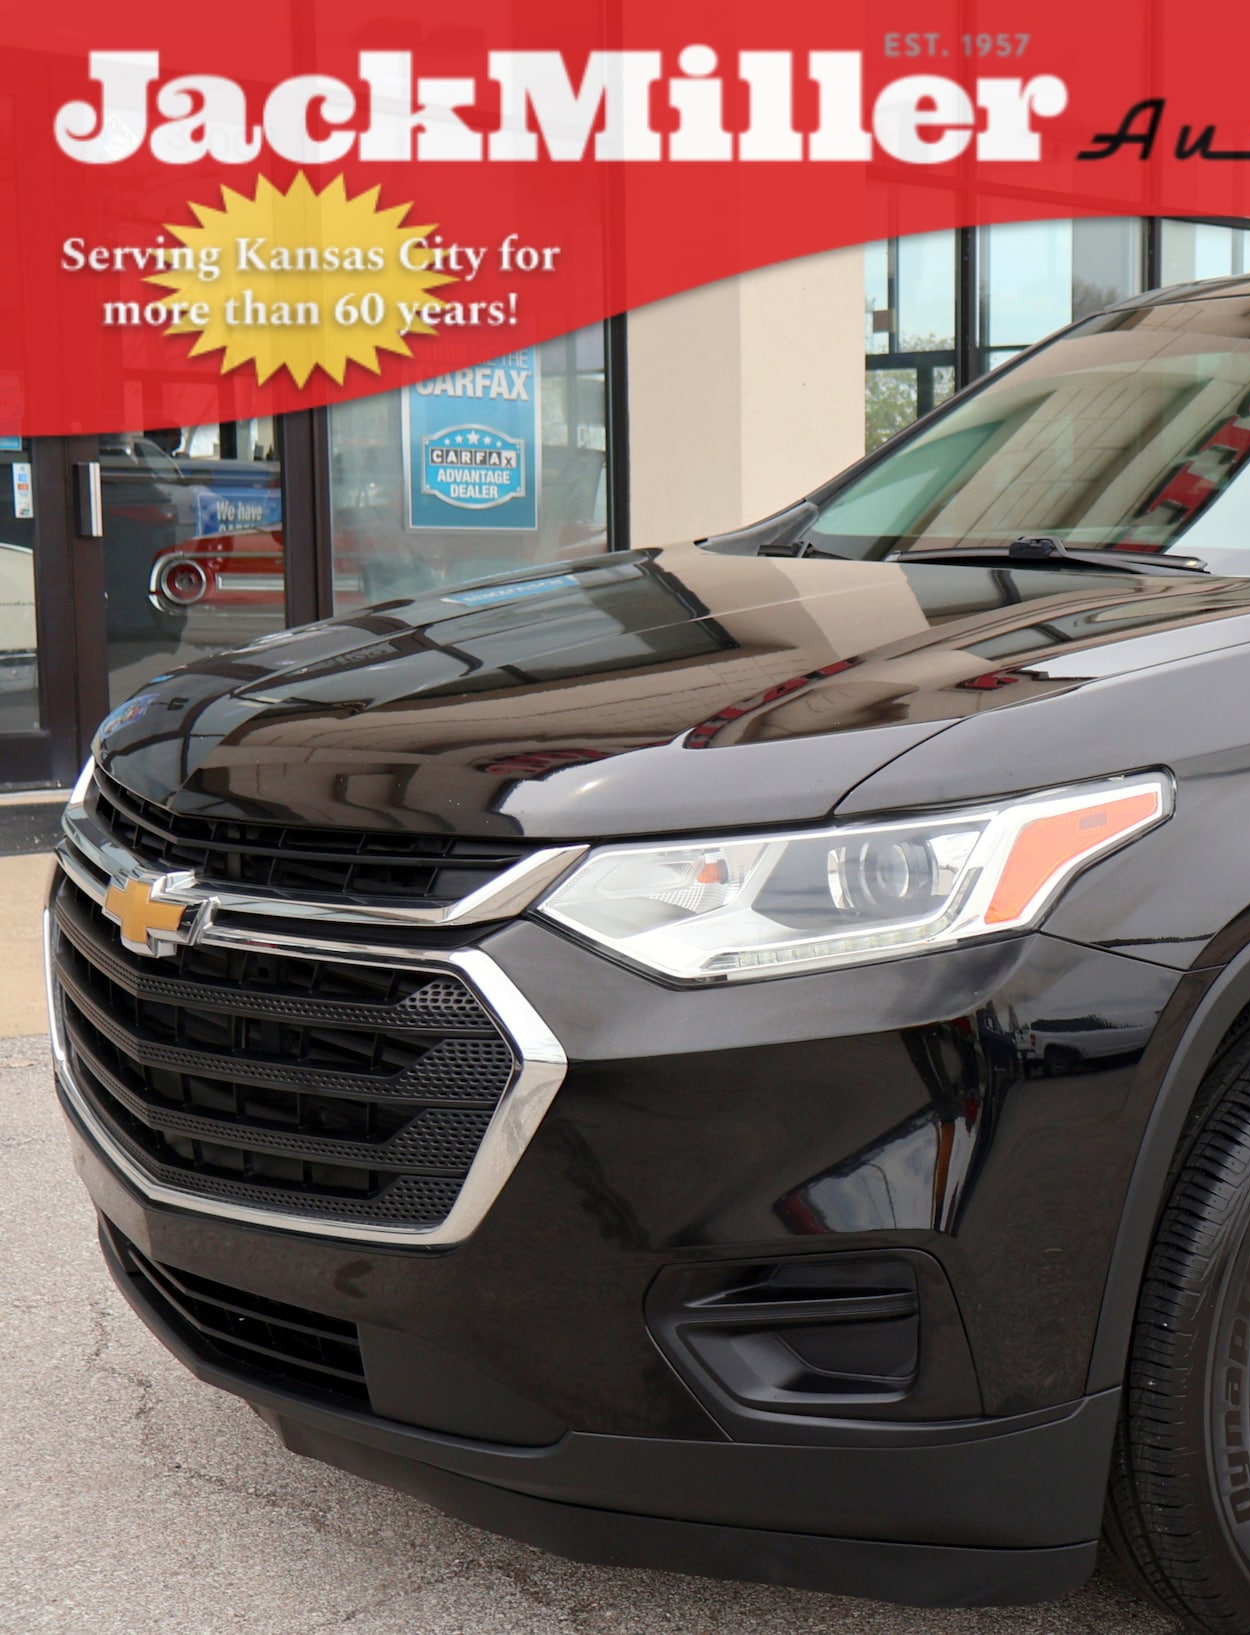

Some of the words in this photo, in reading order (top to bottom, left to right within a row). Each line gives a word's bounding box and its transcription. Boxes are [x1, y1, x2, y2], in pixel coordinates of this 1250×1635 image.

[415, 368, 529, 401] CARFAX
[431, 449, 515, 468] CARFAX
[437, 468, 510, 484] ADVANTAGE
[450, 484, 498, 499] DEALER
[217, 501, 235, 521] We
[237, 501, 263, 521] have
